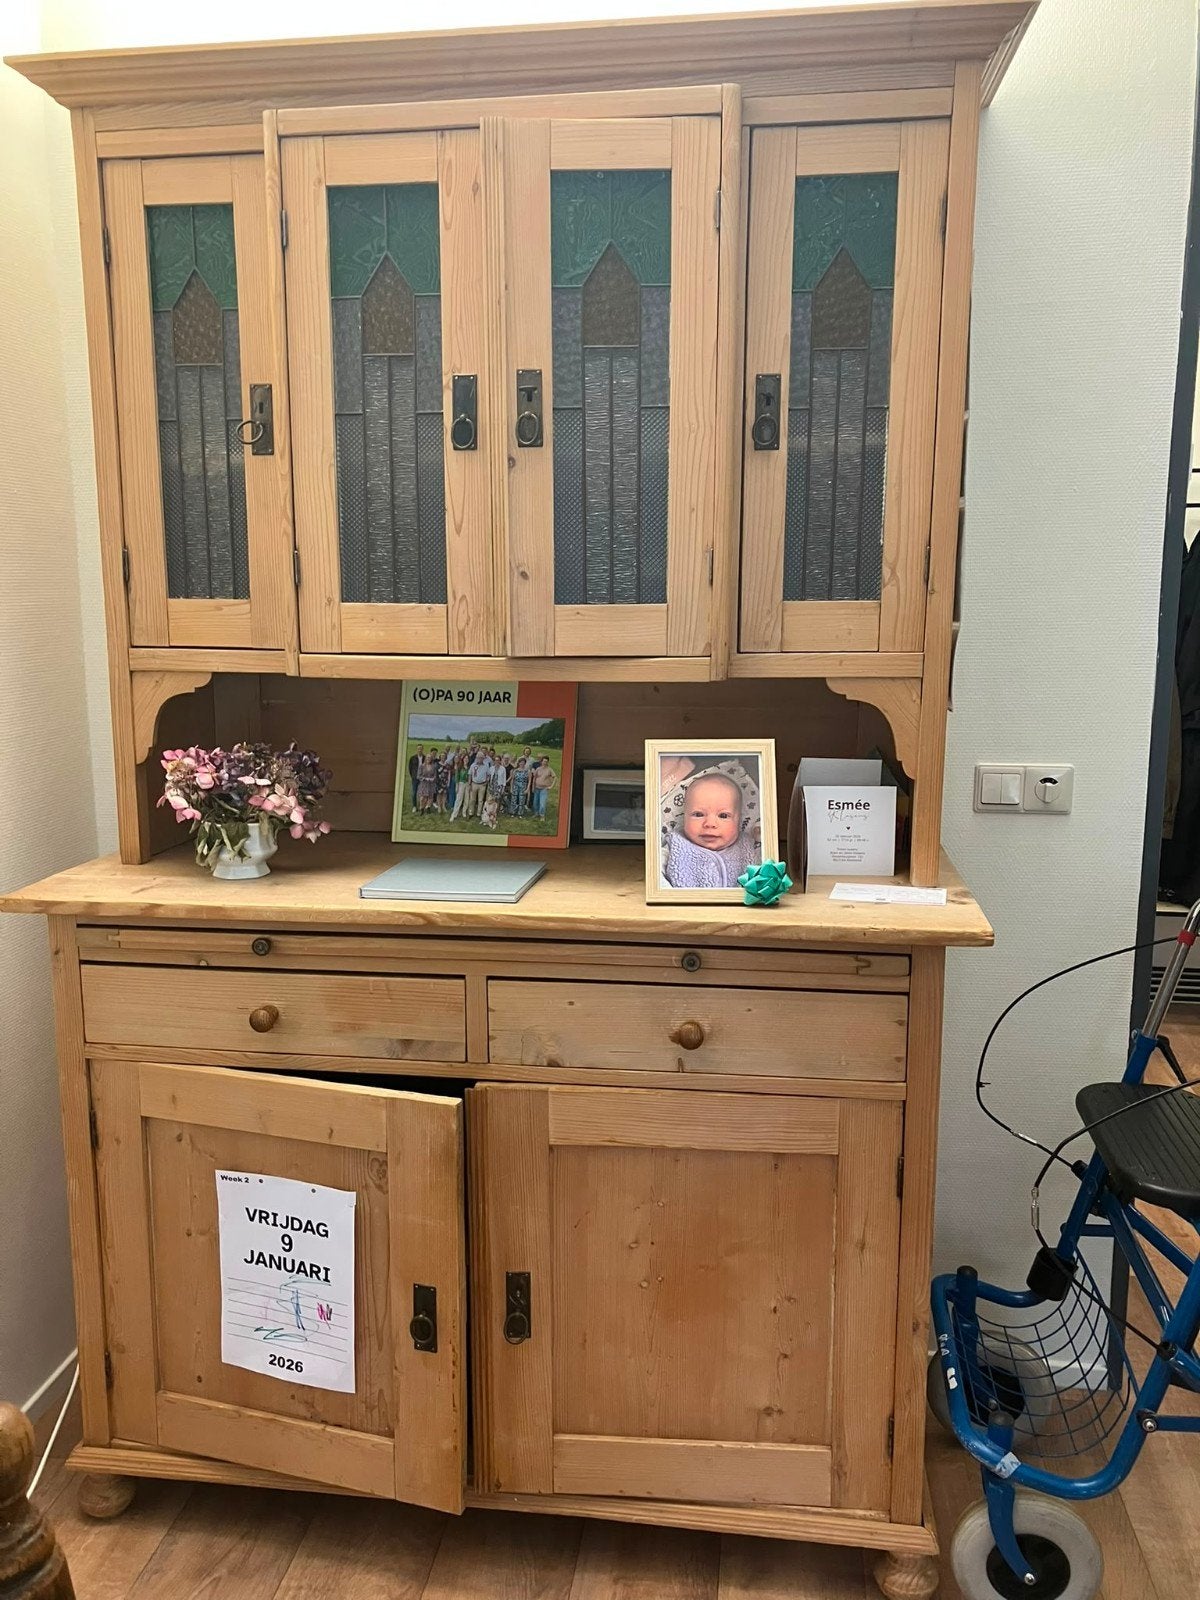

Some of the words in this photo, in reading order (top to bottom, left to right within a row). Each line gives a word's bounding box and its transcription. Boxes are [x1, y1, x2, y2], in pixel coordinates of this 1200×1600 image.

[413, 687, 453, 704] (O)PA
[457, 690, 475, 702] 90
[478, 691, 512, 704] JAAR
[828, 799, 871, 811] Esmée
[220, 1174, 243, 1184] Week
[244, 1176, 250, 1184] 2
[245, 1207, 329, 1238] VRIJDAG
[281, 1233, 293, 1253] 9
[243, 1249, 331, 1283] JANUARI
[268, 1353, 304, 1373] 2026
